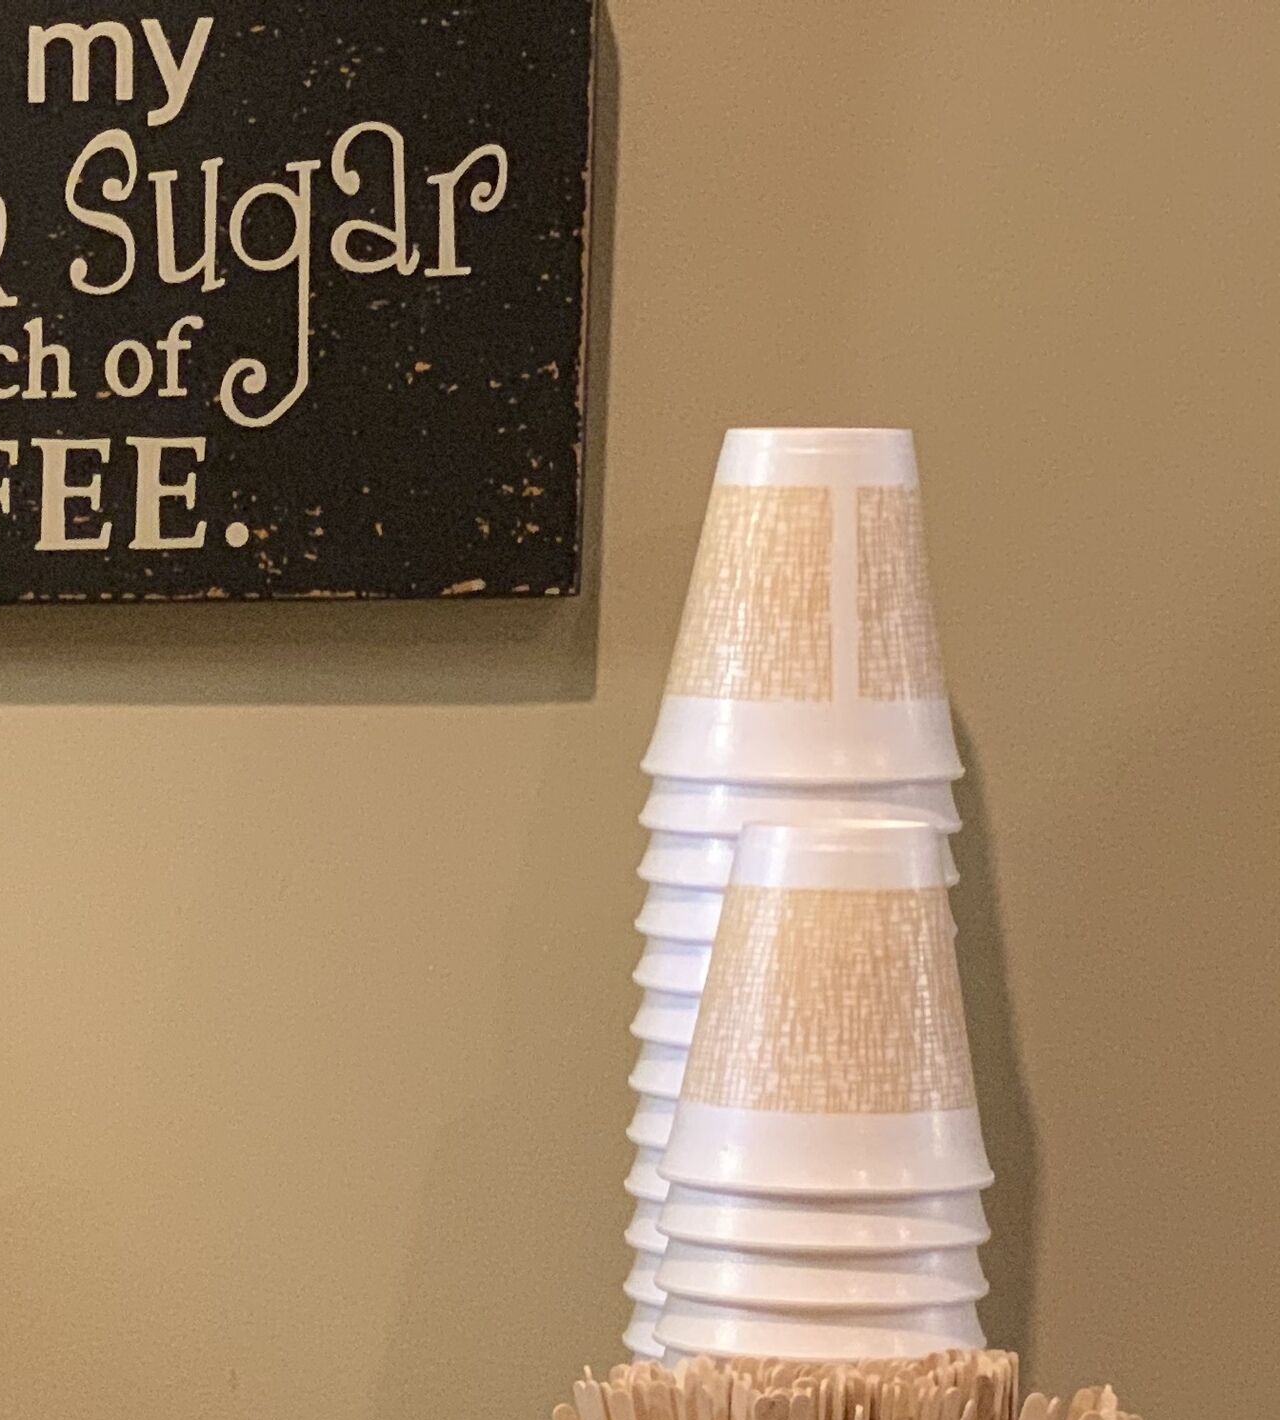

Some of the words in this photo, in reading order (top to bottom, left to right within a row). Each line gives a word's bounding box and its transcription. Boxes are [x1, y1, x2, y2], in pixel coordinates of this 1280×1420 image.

[28, 17, 214, 127] my
[64, 121, 508, 428] Sugar
[104, 315, 204, 399] of
